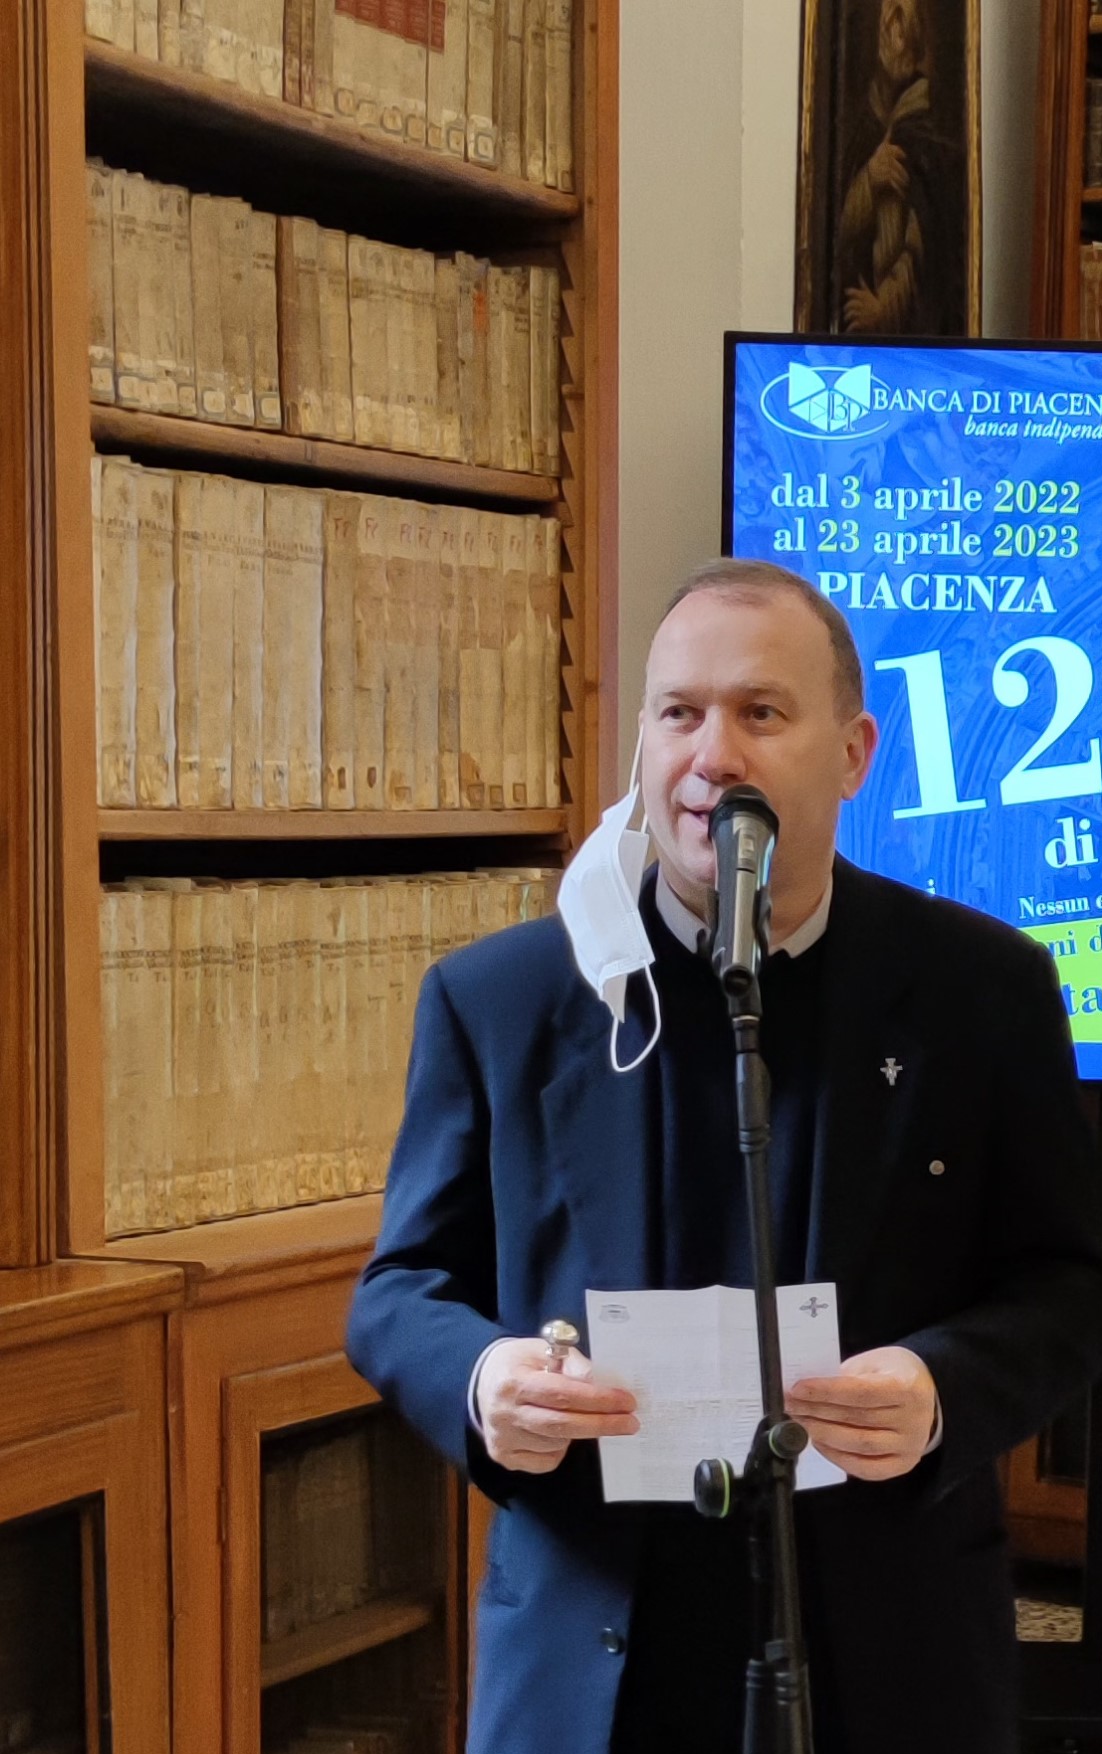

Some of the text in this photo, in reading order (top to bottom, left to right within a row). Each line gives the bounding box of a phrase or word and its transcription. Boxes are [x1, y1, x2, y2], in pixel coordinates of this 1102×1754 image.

[874, 388, 964, 414] BANCA
[970, 392, 1001, 414] DI
[964, 416, 1018, 438] banca
[770, 473, 1082, 520] dal 3 aprile 2022
[772, 518, 1080, 565] al 23 aprile 2023
[815, 570, 1058, 614] PIACENZA
[874, 635, 1102, 820] 12
[1044, 815, 1099, 870] di
[1019, 895, 1090, 920] Nessun
